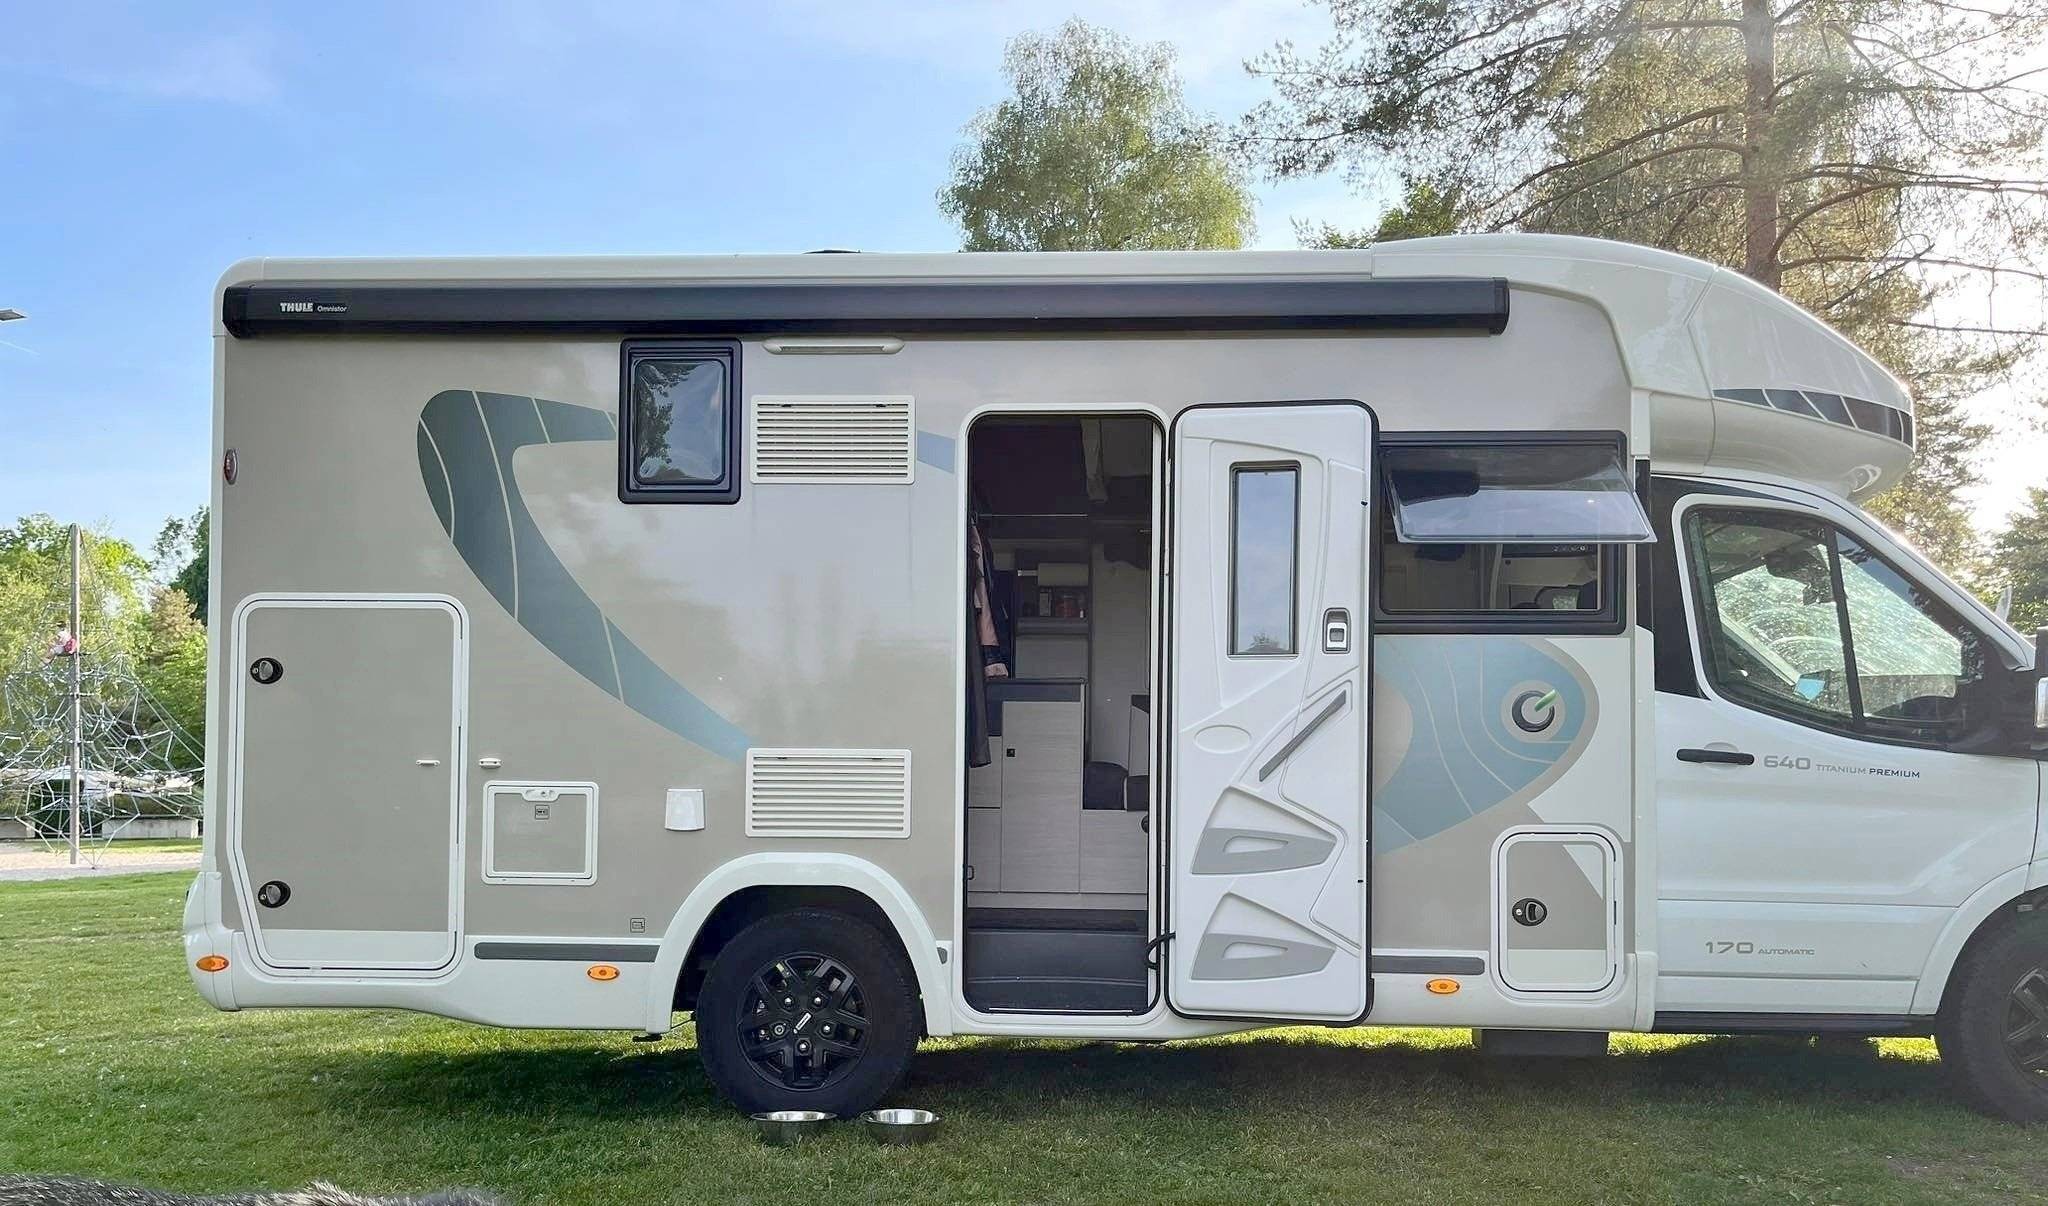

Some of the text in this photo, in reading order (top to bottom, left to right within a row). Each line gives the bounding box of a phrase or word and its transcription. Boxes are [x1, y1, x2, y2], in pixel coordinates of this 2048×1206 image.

[280, 302, 347, 313] THULE Omnistor
[1763, 755, 1920, 779] 640 TITANIUM PREMIUM
[1705, 941, 1815, 956] 170 AUTOMATIC
